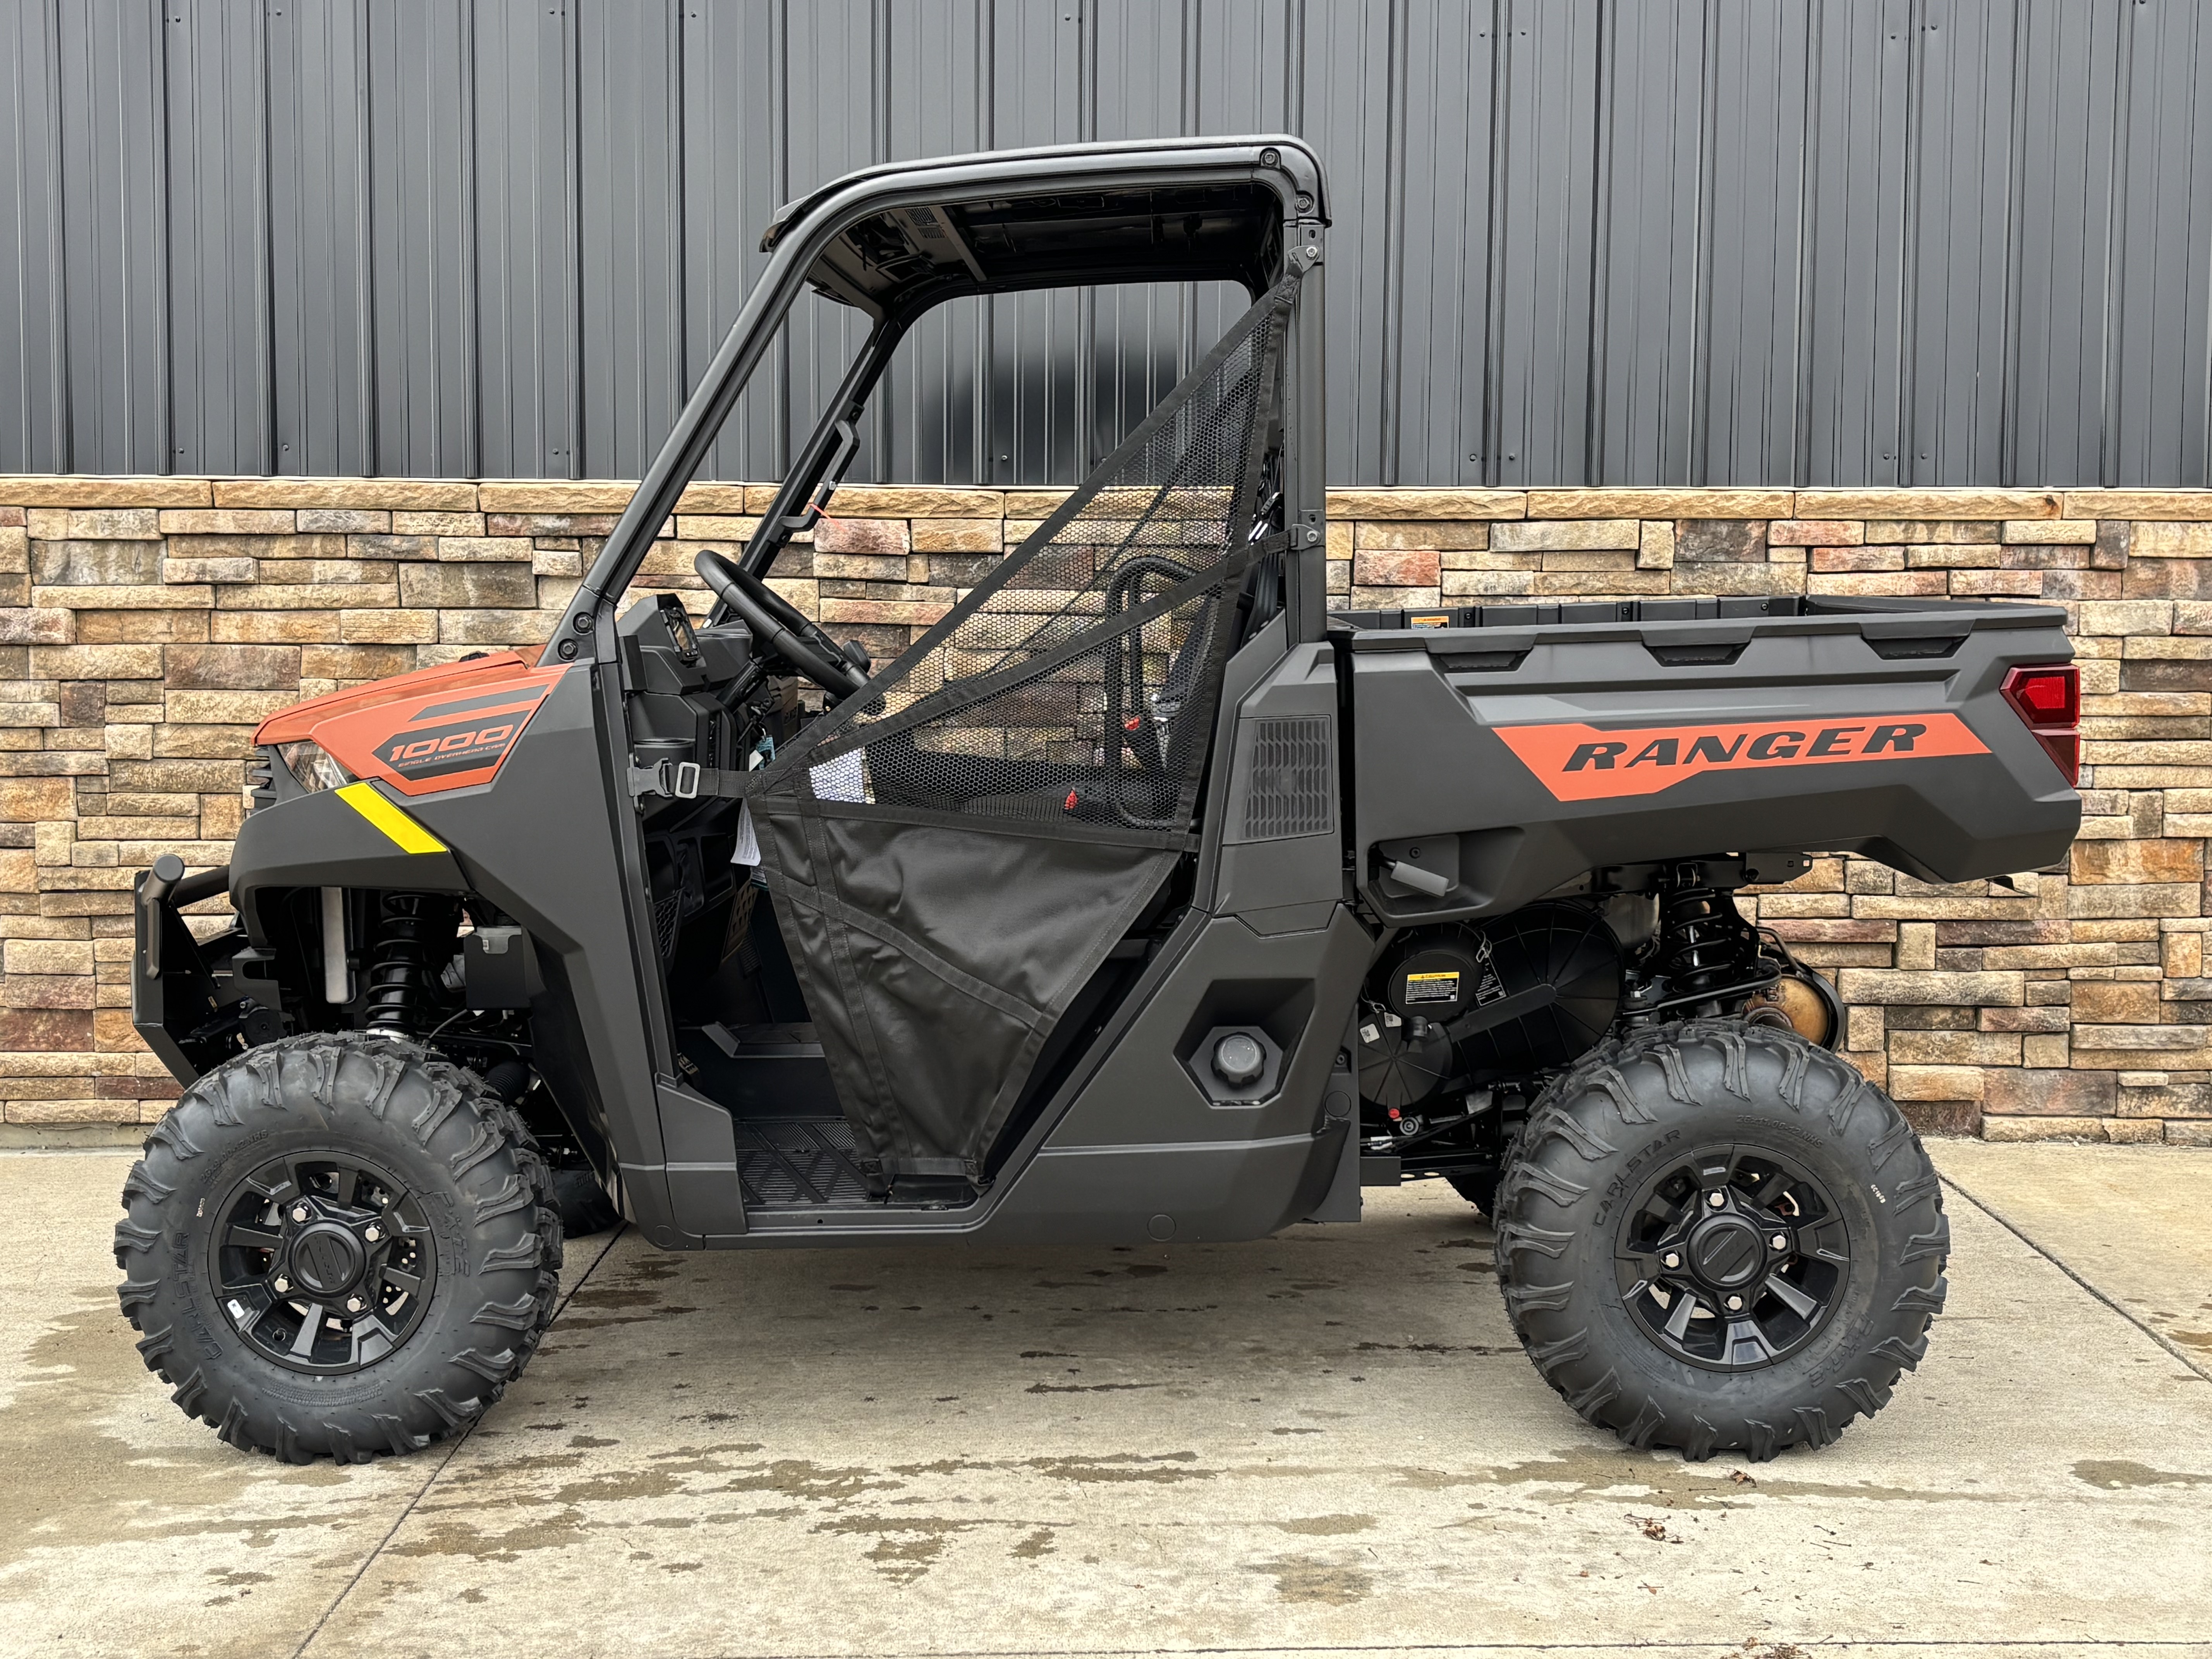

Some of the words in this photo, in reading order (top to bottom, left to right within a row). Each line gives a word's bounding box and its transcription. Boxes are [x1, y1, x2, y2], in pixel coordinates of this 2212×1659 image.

[389, 724, 514, 762] 1000
[398, 757, 431, 768] SINGLE
[434, 747, 484, 760] OVERHEAD
[1562, 723, 1927, 772] RANGER
[1592, 1129, 1681, 1228] CARLSTAR
[172, 1231, 223, 1360] CARLSTAR
